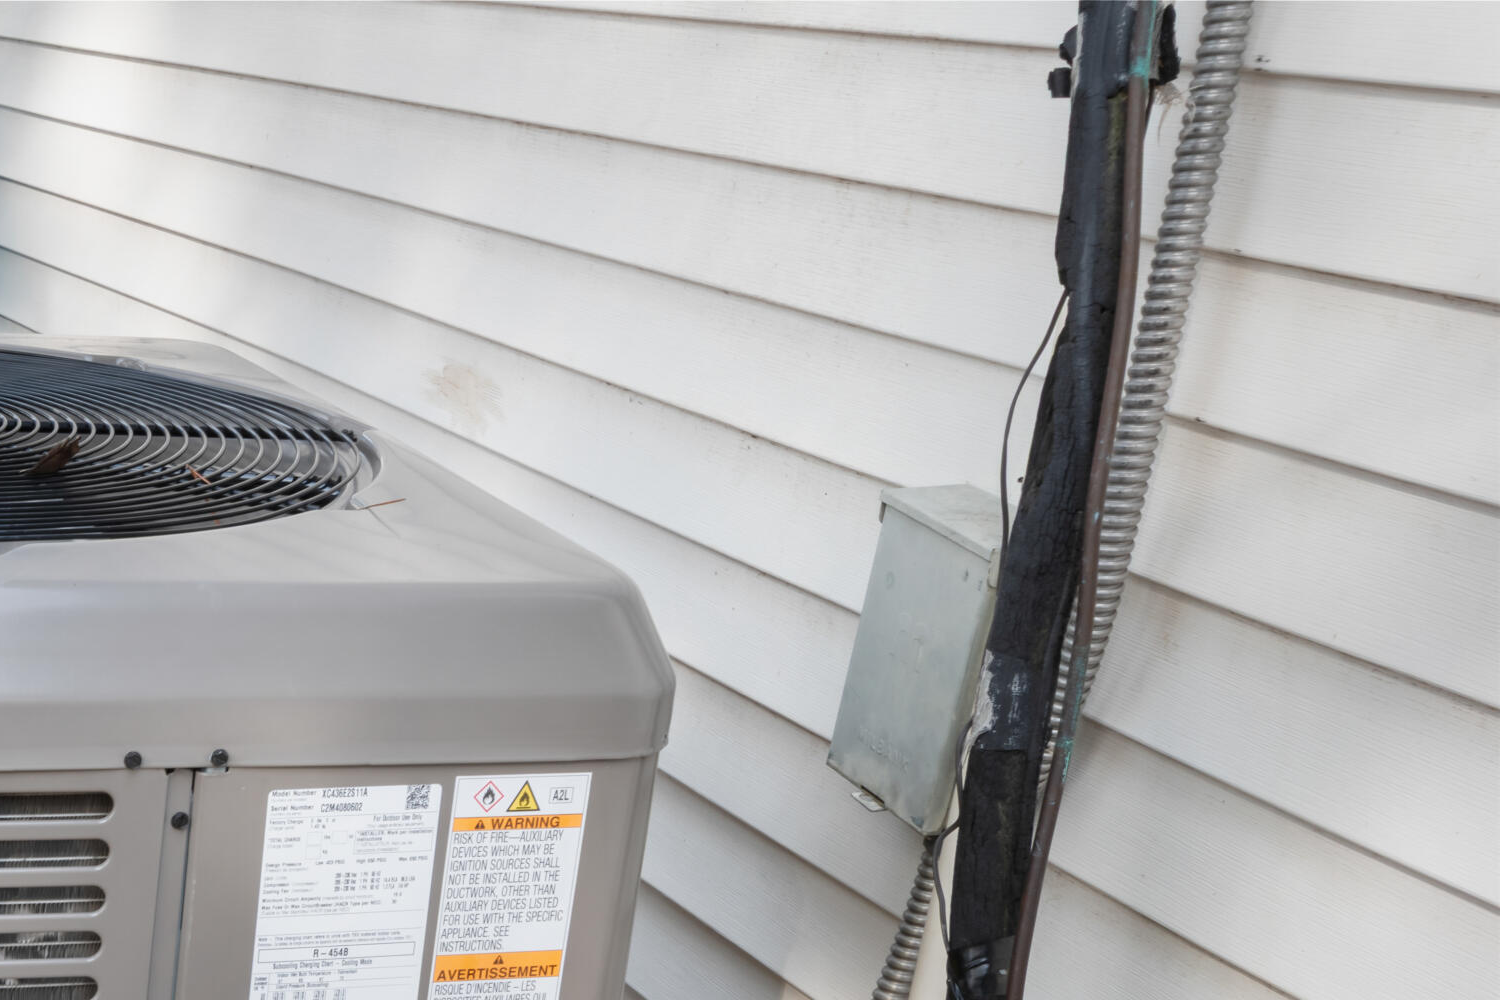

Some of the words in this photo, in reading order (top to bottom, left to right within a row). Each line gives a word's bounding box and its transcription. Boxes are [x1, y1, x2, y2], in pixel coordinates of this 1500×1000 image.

[553, 790, 570, 801] A2L
[491, 816, 561, 829] WARNING
[453, 833, 474, 844] RISK
[476, 832, 488, 843] OF
[452, 846, 489, 858] DEVICES
[490, 845, 520, 857] WHICH
[522, 844, 541, 856] MAY
[543, 844, 555, 855] BE
[450, 860, 488, 872] IGNITION
[490, 858, 531, 870] SOURCES
[533, 857, 561, 869] SHALL
[448, 874, 466, 885] NOT
[469, 873, 480, 885] BE
[483, 872, 529, 884] INSTALLED
[532, 871, 541, 882] IN
[544, 871, 561, 882] THE
[501, 885, 530, 897] OTHER
[532, 884, 556, 895] THAN
[444, 900, 489, 912] AUXILIARY
[491, 898, 527, 910] DEVICES
[529, 897, 559, 909] LISTED
[443, 914, 461, 926] FOR
[463, 913, 480, 925] USE
[482, 912, 505, 924] WITH
[507, 912, 524, 923] THE
[525, 910, 564, 922] SPECIFIC
[493, 926, 510, 937] SEE
[313, 949, 319, 957] R
[328, 948, 349, 957] 454B
[437, 965, 557, 981] AVERTISSEMENT
[434, 984, 464, 995] RISQUE
[521, 981, 537, 991] LES
